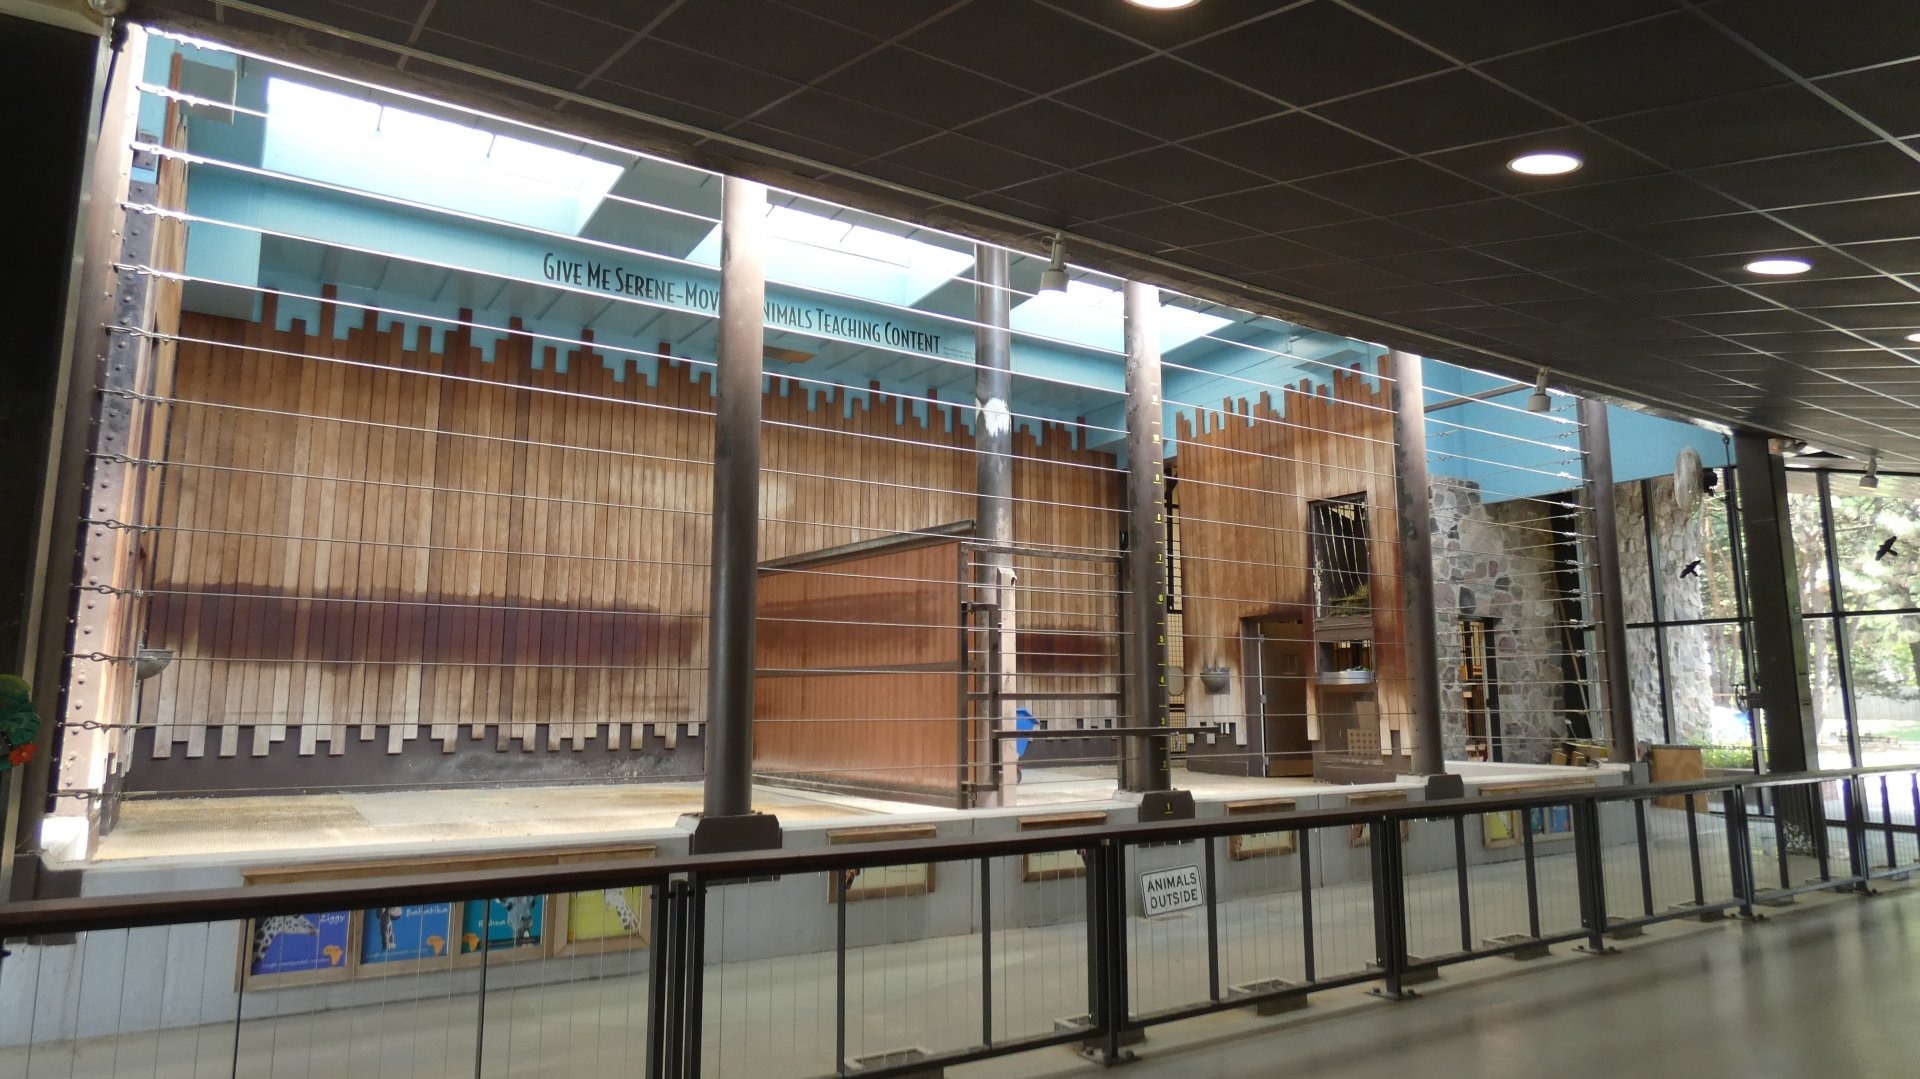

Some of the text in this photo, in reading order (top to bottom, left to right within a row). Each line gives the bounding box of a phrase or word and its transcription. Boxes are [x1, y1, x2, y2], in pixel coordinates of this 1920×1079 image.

[543, 252, 720, 312] GIVE ME SERENE-MOV
[763, 301, 813, 330] NIMALS
[816, 308, 881, 343] TEACHING
[884, 321, 941, 354] CONTENT
[1147, 872, 1197, 893] ANIMALS
[1150, 889, 1198, 909] OUTSIDE
